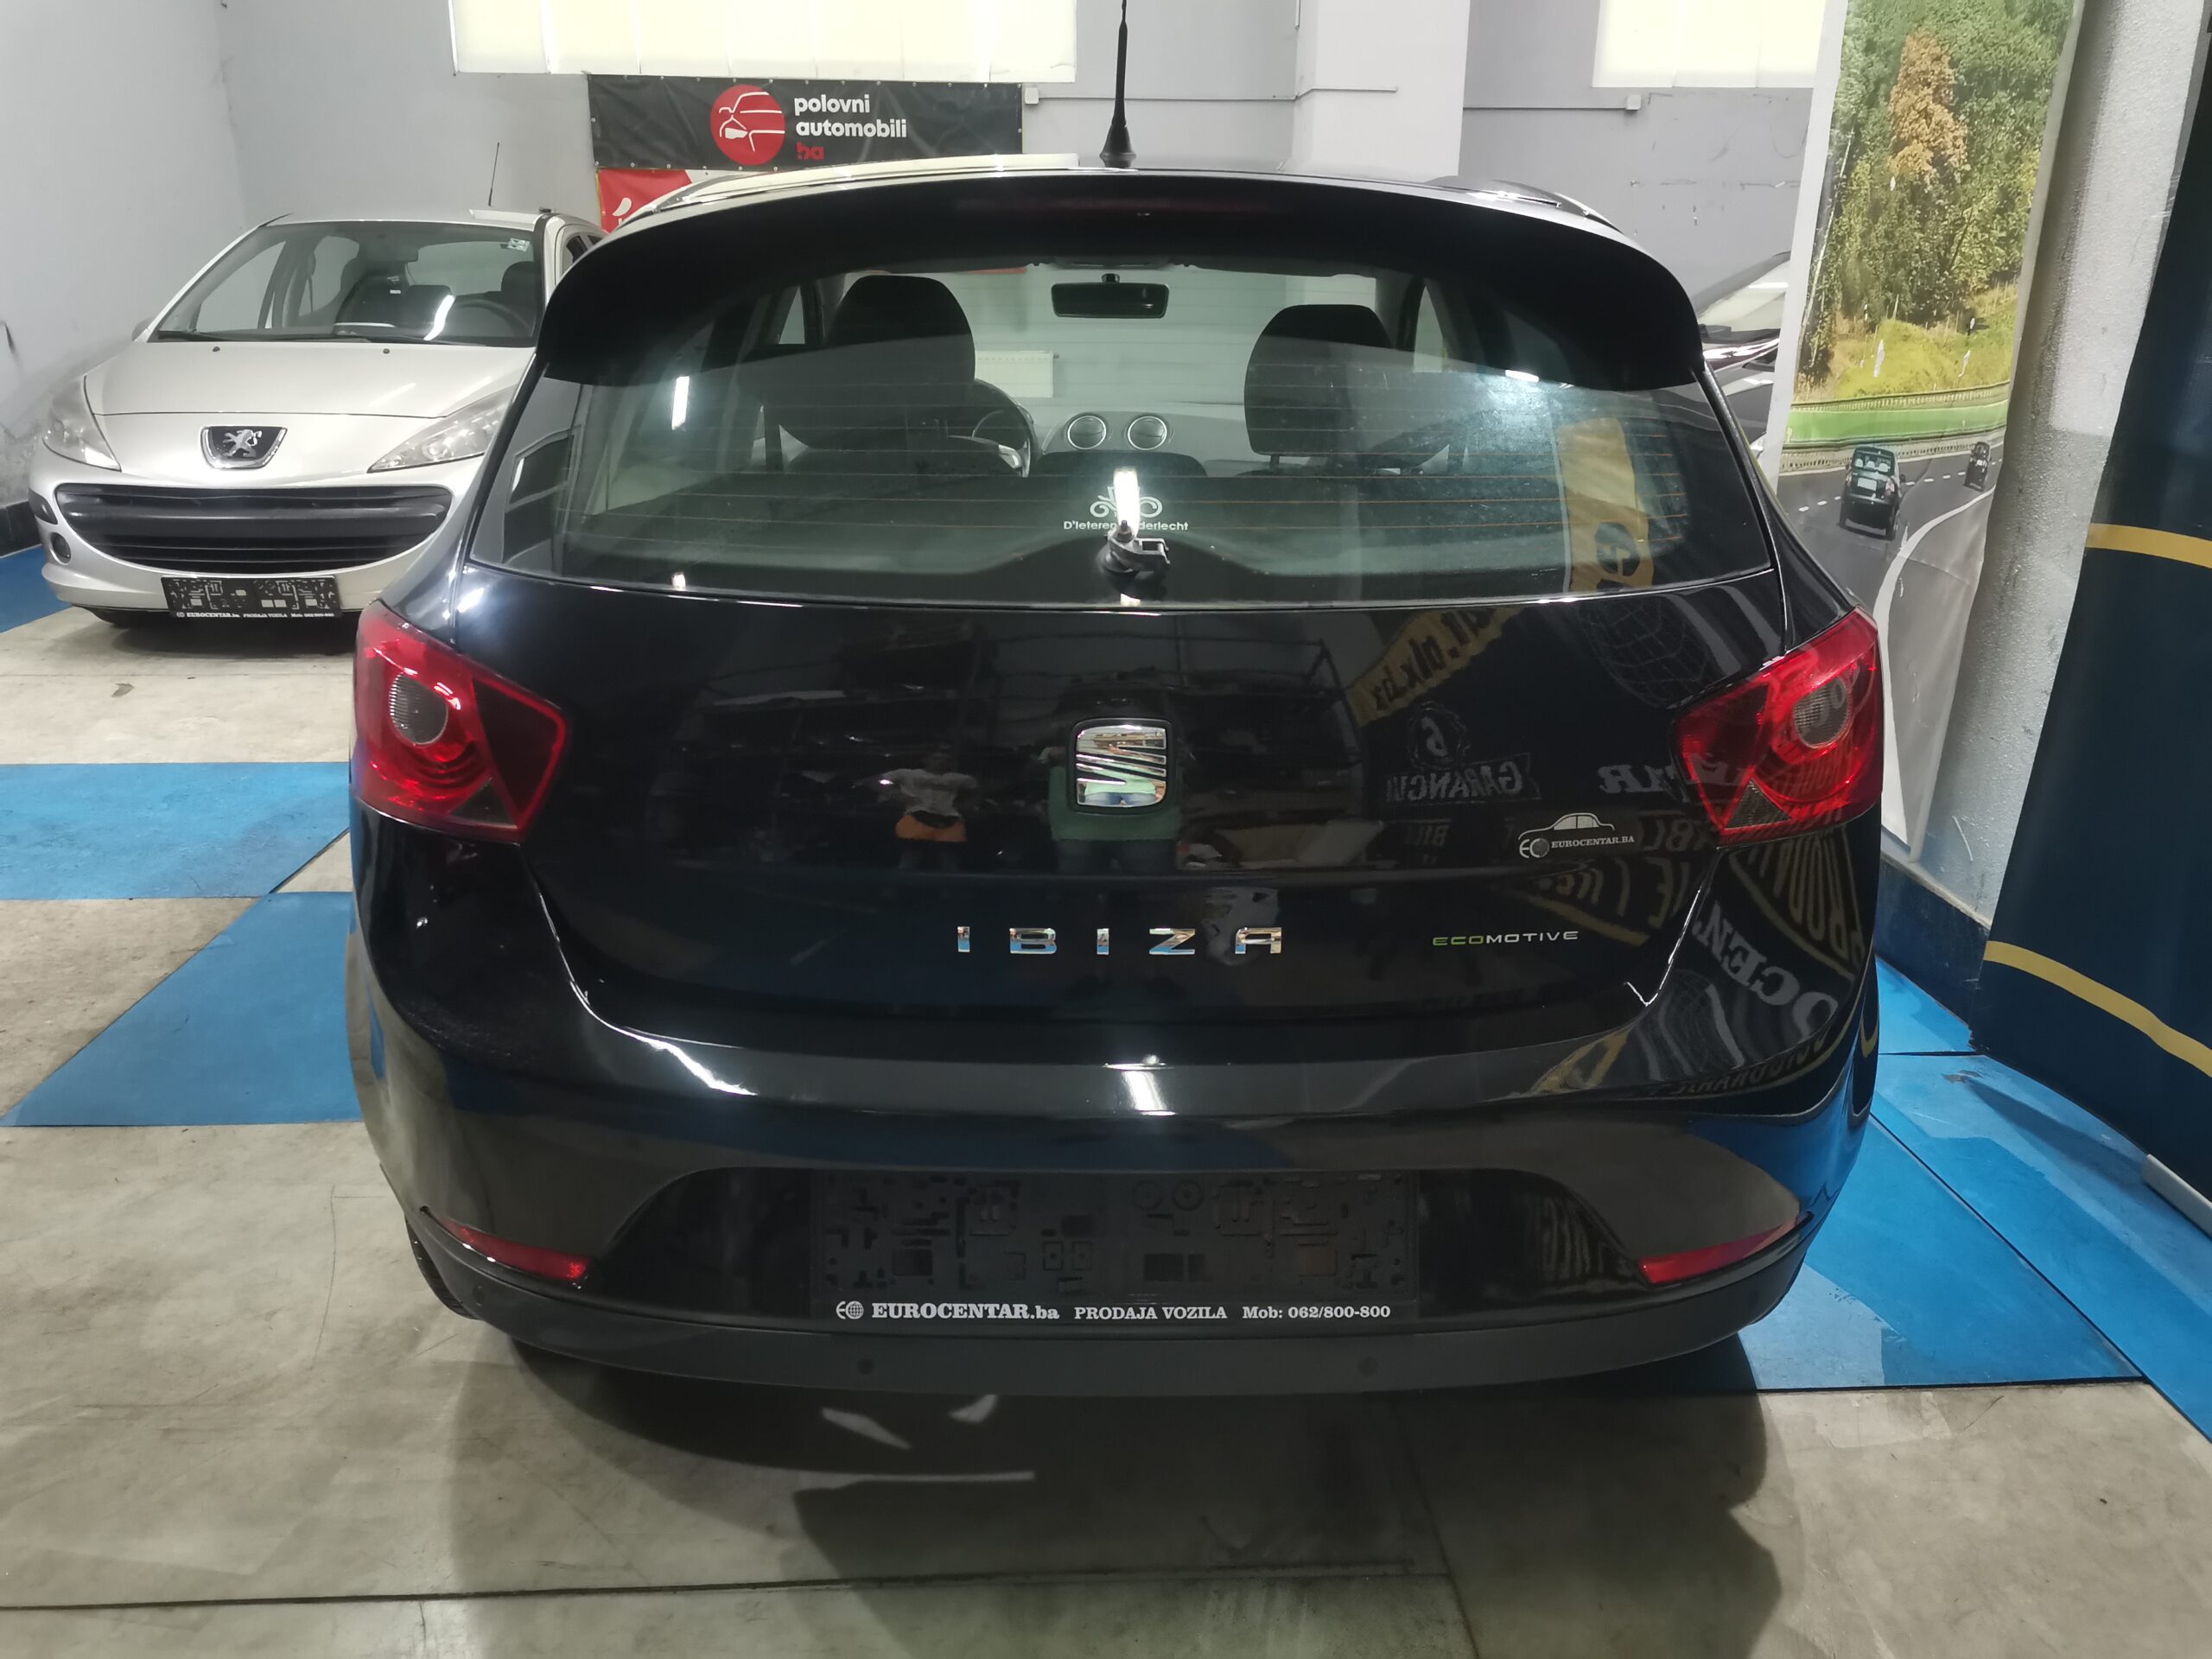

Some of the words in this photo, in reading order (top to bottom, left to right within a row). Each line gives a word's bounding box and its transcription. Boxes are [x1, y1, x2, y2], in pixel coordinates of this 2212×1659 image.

[794, 94, 870, 116] polovni
[796, 118, 907, 137] automobili
[1551, 836, 1635, 849] EUROCENTAR.BA
[957, 925, 1283, 955] IBIZA
[1432, 930, 1580, 946] ECOMOTIVE
[872, 1302, 1060, 1319] EUROCENTAR.ba
[1074, 1306, 1158, 1320] PRODAJA
[1162, 1306, 1228, 1320] VOZILA
[1242, 1306, 1283, 1319] Mob:
[1287, 1305, 1391, 1319] 062/800-800
